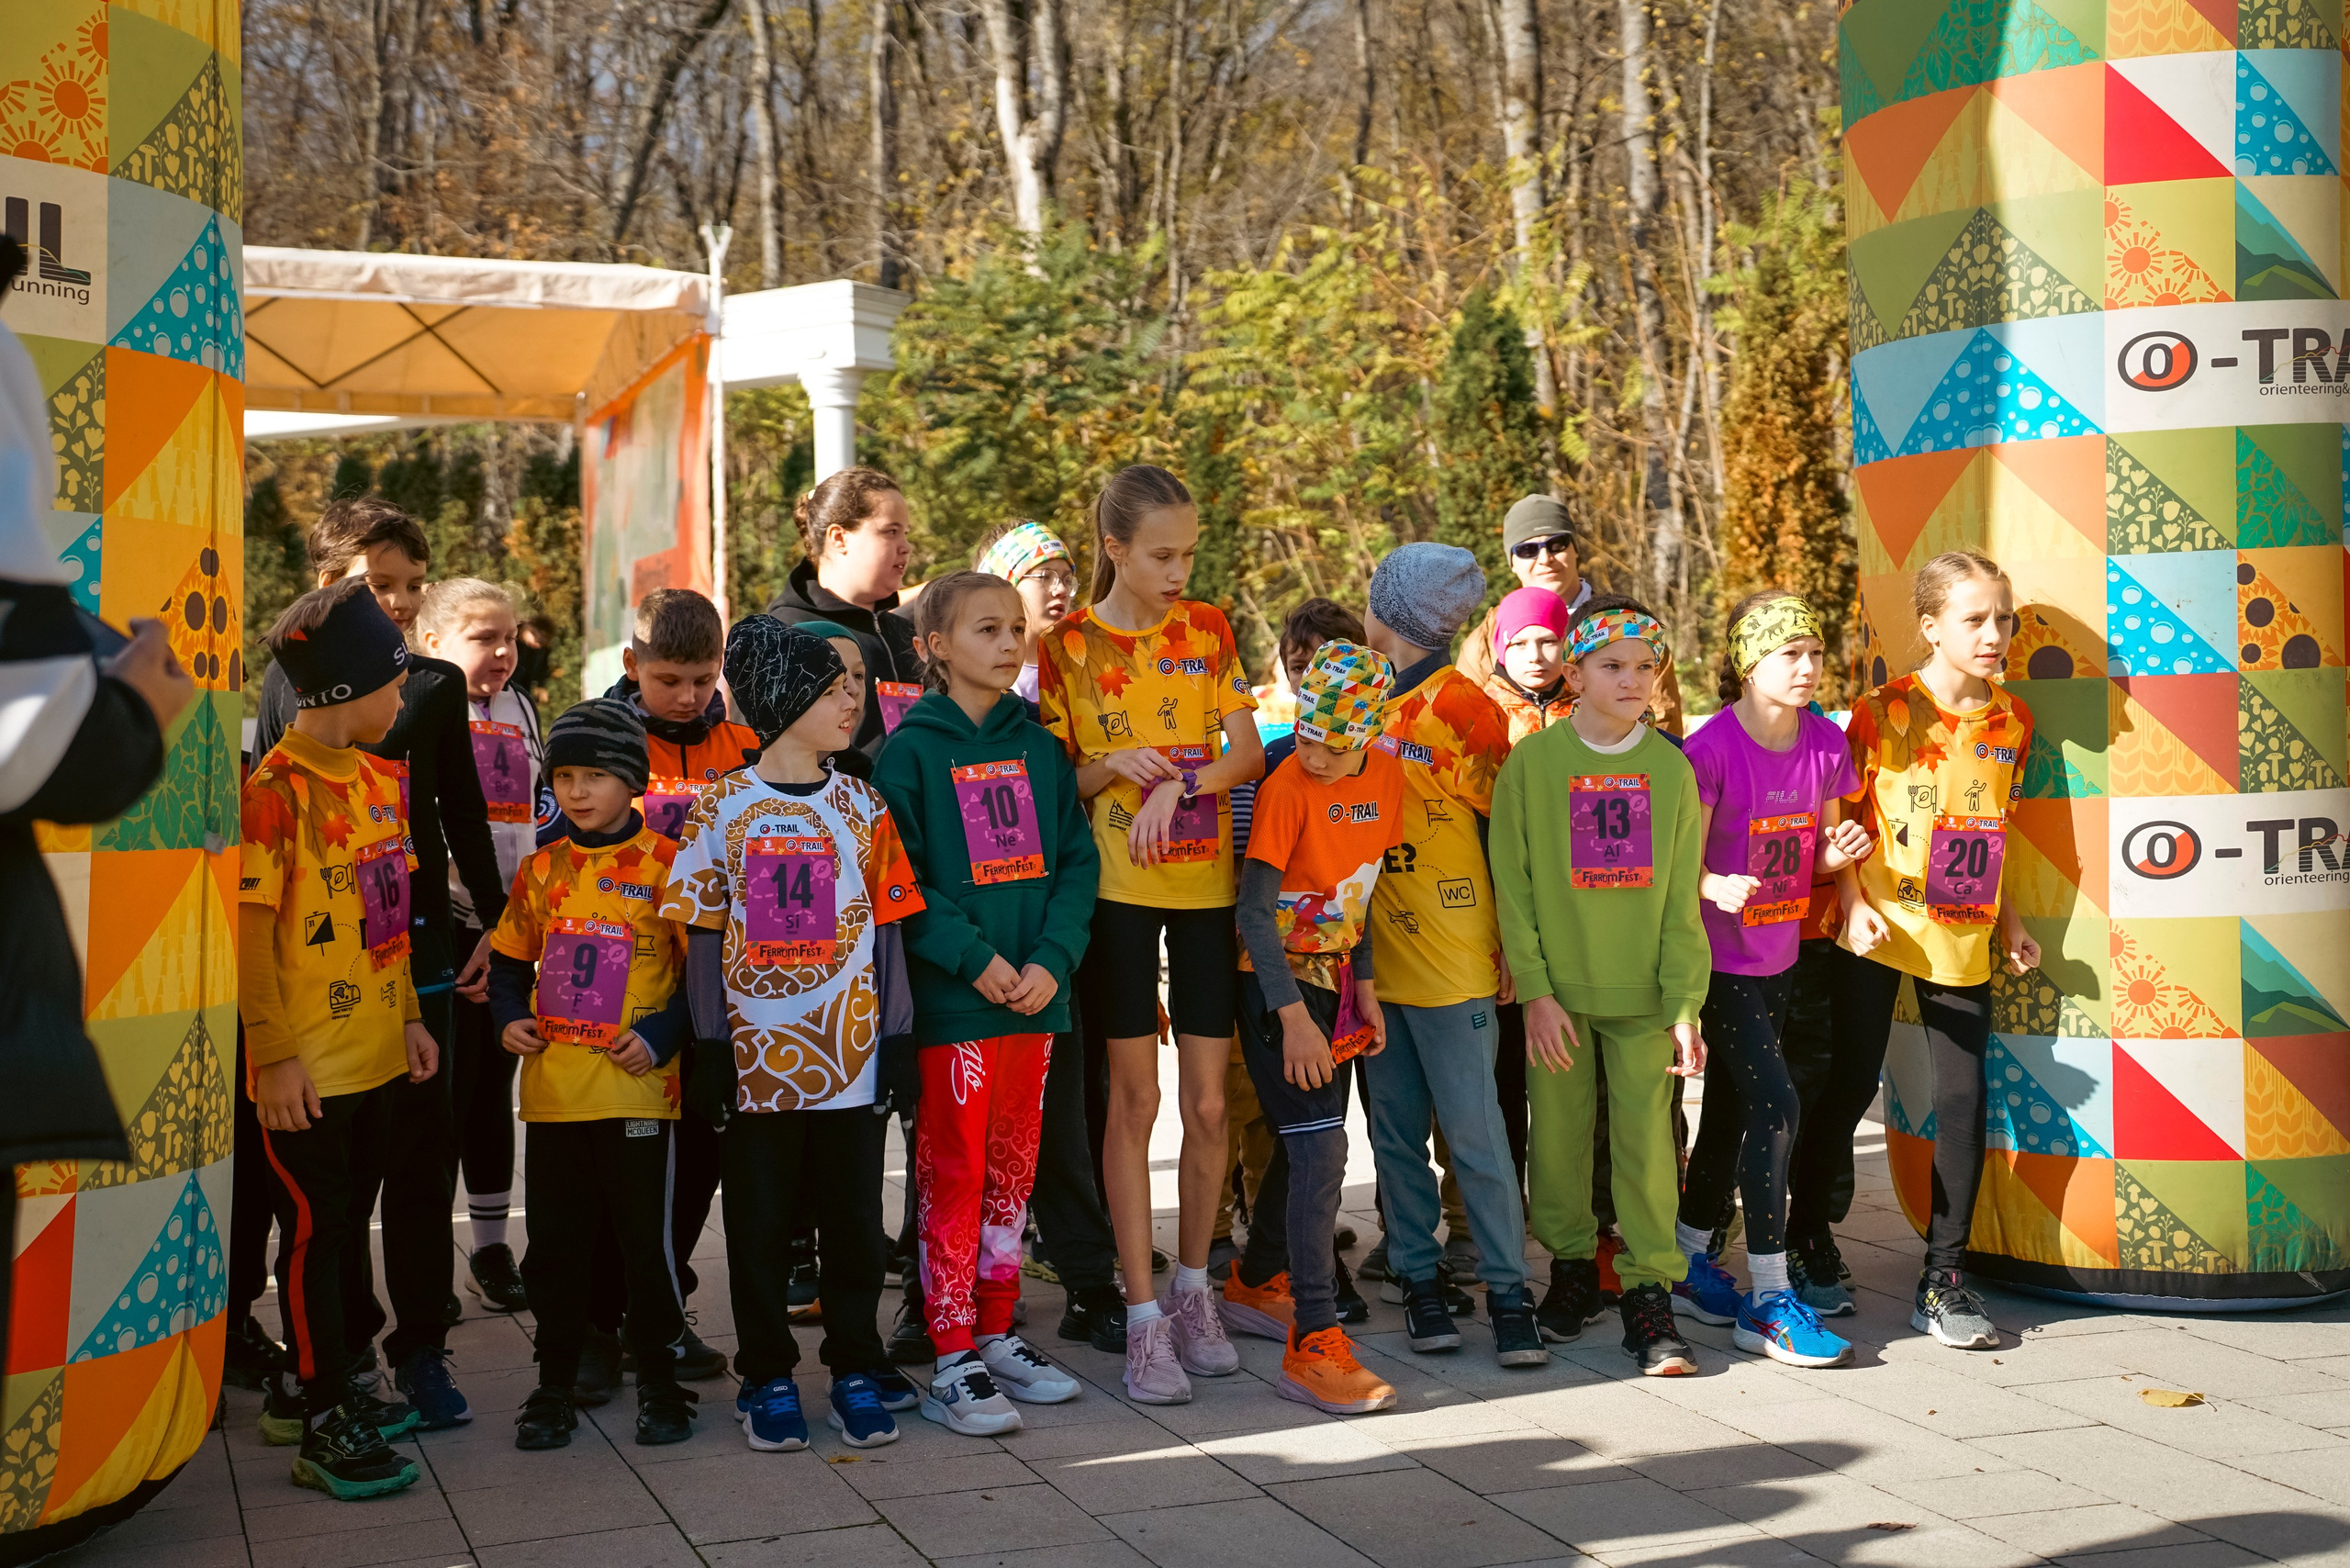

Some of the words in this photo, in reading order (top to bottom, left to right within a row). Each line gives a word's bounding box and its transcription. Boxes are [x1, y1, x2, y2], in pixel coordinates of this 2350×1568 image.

[11, 278, 90, 306] unning
[494, 742, 509, 777] 4
[1169, 746, 1203, 758] O-TRAIL
[986, 763, 1019, 776] O-TRAIL
[1604, 777, 1640, 788] O-TRAIL
[1765, 789, 1798, 804] FILA
[980, 785, 1019, 830] 10
[1327, 801, 1380, 824] O-TRAIL
[1592, 798, 1630, 839] 13
[1778, 816, 1808, 827] O-TRAIL
[1965, 817, 1999, 829] O-TRAIL
[759, 823, 800, 834] O-TRAIL
[786, 838, 825, 852] O-TRAIL
[995, 834, 1016, 848] Ne
[1763, 835, 1801, 879] 28
[1944, 837, 1988, 879] 20
[374, 861, 400, 913] 16
[599, 878, 653, 901] O-TRAIL
[771, 863, 814, 909] 14
[1773, 879, 1787, 894] Ni
[1953, 881, 1973, 895] Ca
[1443, 886, 1470, 902] WC
[585, 920, 624, 936] O-TRAIL
[785, 914, 800, 928] Si
[571, 943, 598, 989] 9
[573, 993, 583, 1007] F
[626, 1119, 657, 1128] LIGHTNING
[627, 1126, 658, 1137] MCQUEEN
